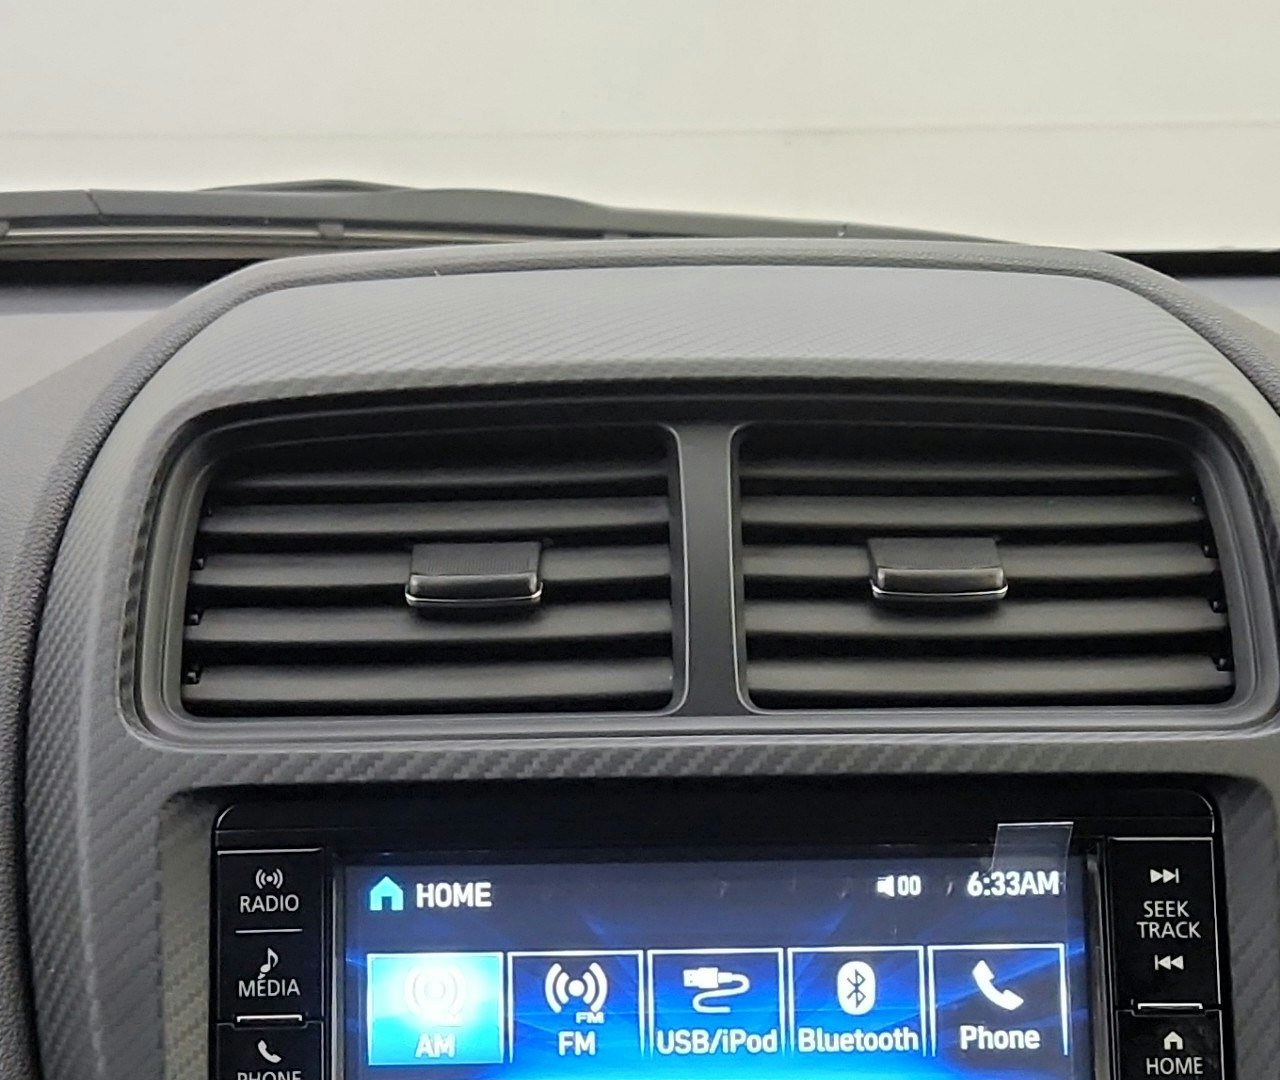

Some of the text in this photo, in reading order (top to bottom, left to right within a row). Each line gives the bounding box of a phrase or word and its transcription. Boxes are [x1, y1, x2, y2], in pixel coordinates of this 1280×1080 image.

[415, 882, 492, 908] HOME
[966, 870, 1060, 897] 6:33AM
[239, 894, 300, 913] RADIO
[1142, 900, 1190, 918] SEEK
[1136, 921, 1201, 939] TRACK
[575, 1011, 605, 1024] FM
[414, 1032, 456, 1058] AM
[558, 1030, 596, 1056] FM
[656, 1028, 778, 1055] USB/iPod
[797, 1026, 919, 1053] Bluetooth
[960, 1024, 1041, 1050] Phone
[1145, 1056, 1204, 1076] HOME
